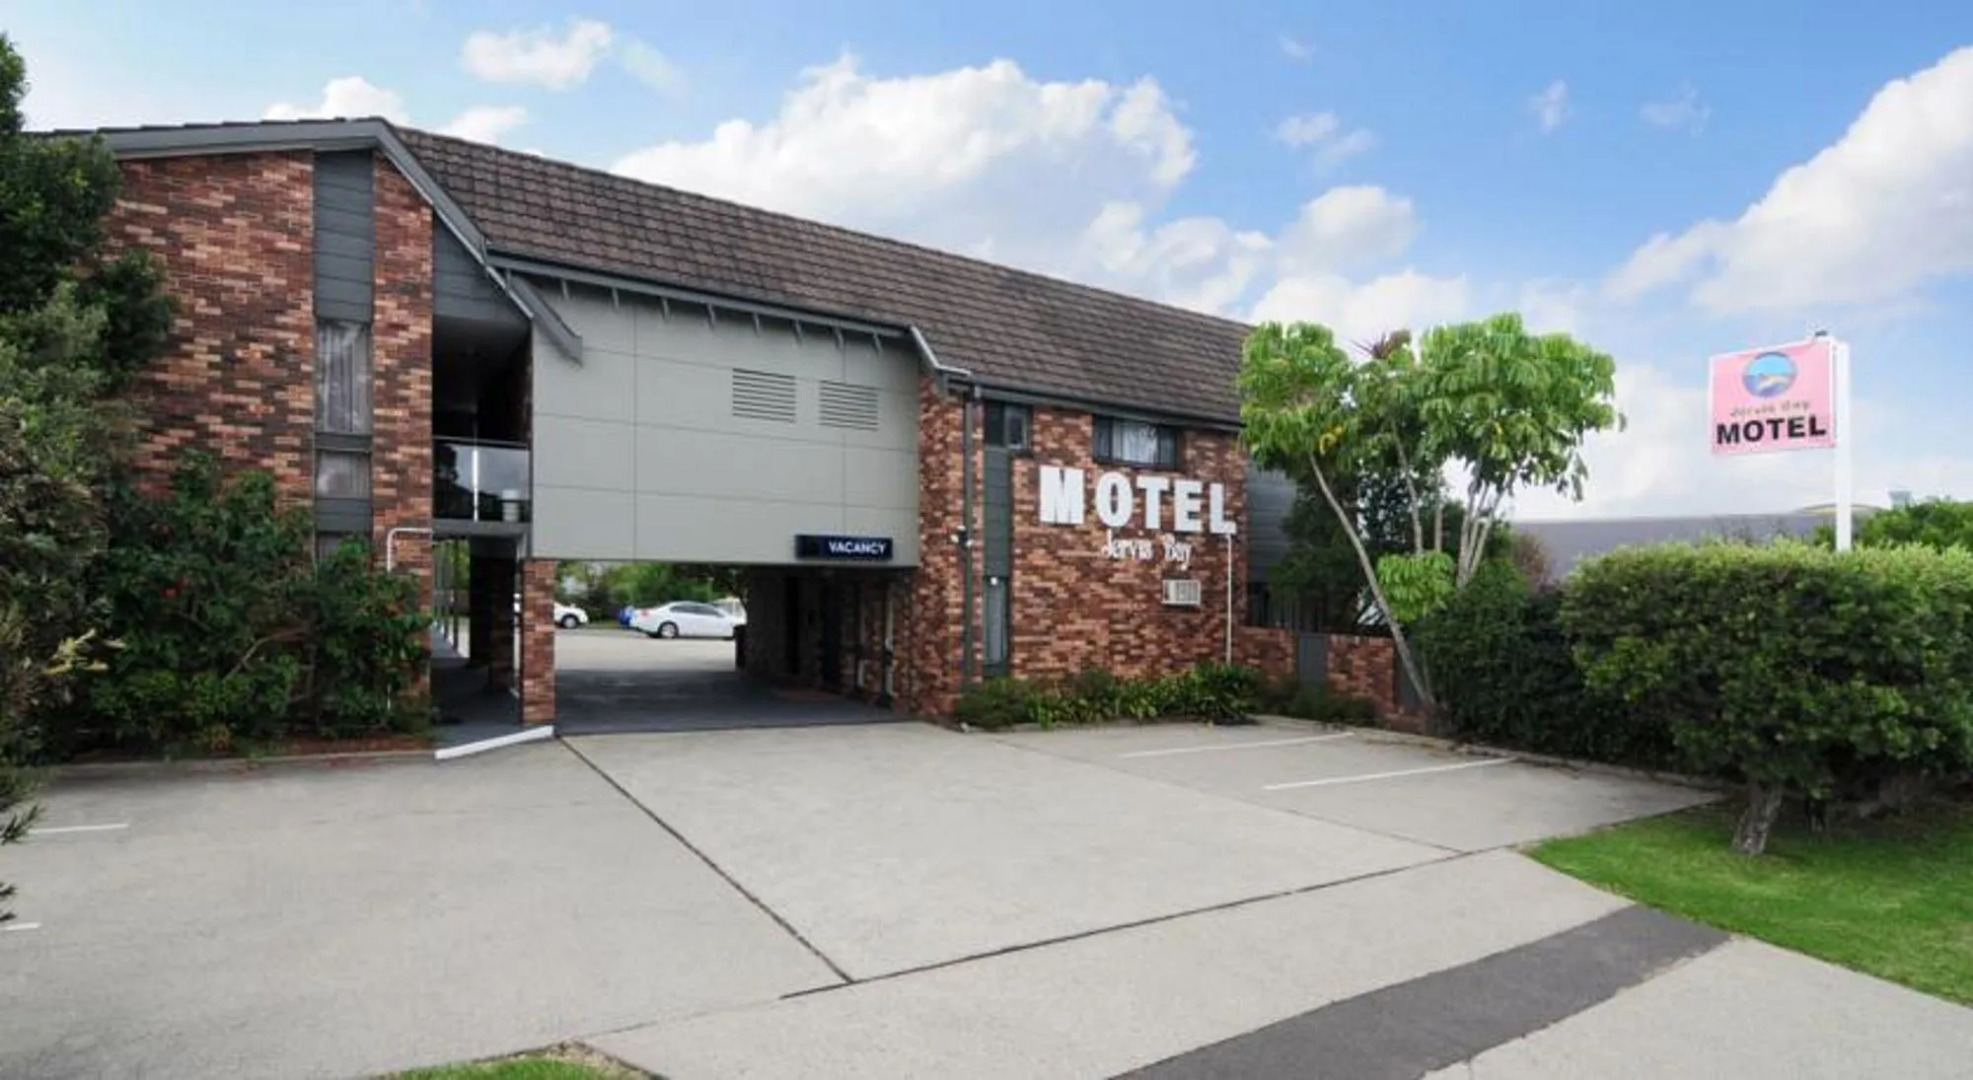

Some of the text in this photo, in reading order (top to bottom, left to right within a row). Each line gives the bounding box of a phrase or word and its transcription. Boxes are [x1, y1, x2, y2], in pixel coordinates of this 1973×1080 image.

[1716, 415, 1828, 445] MOTEL
[1039, 464, 1238, 535] MOTEL
[828, 540, 887, 555] VACANCY
[1101, 528, 1193, 570] Jervis Bay
